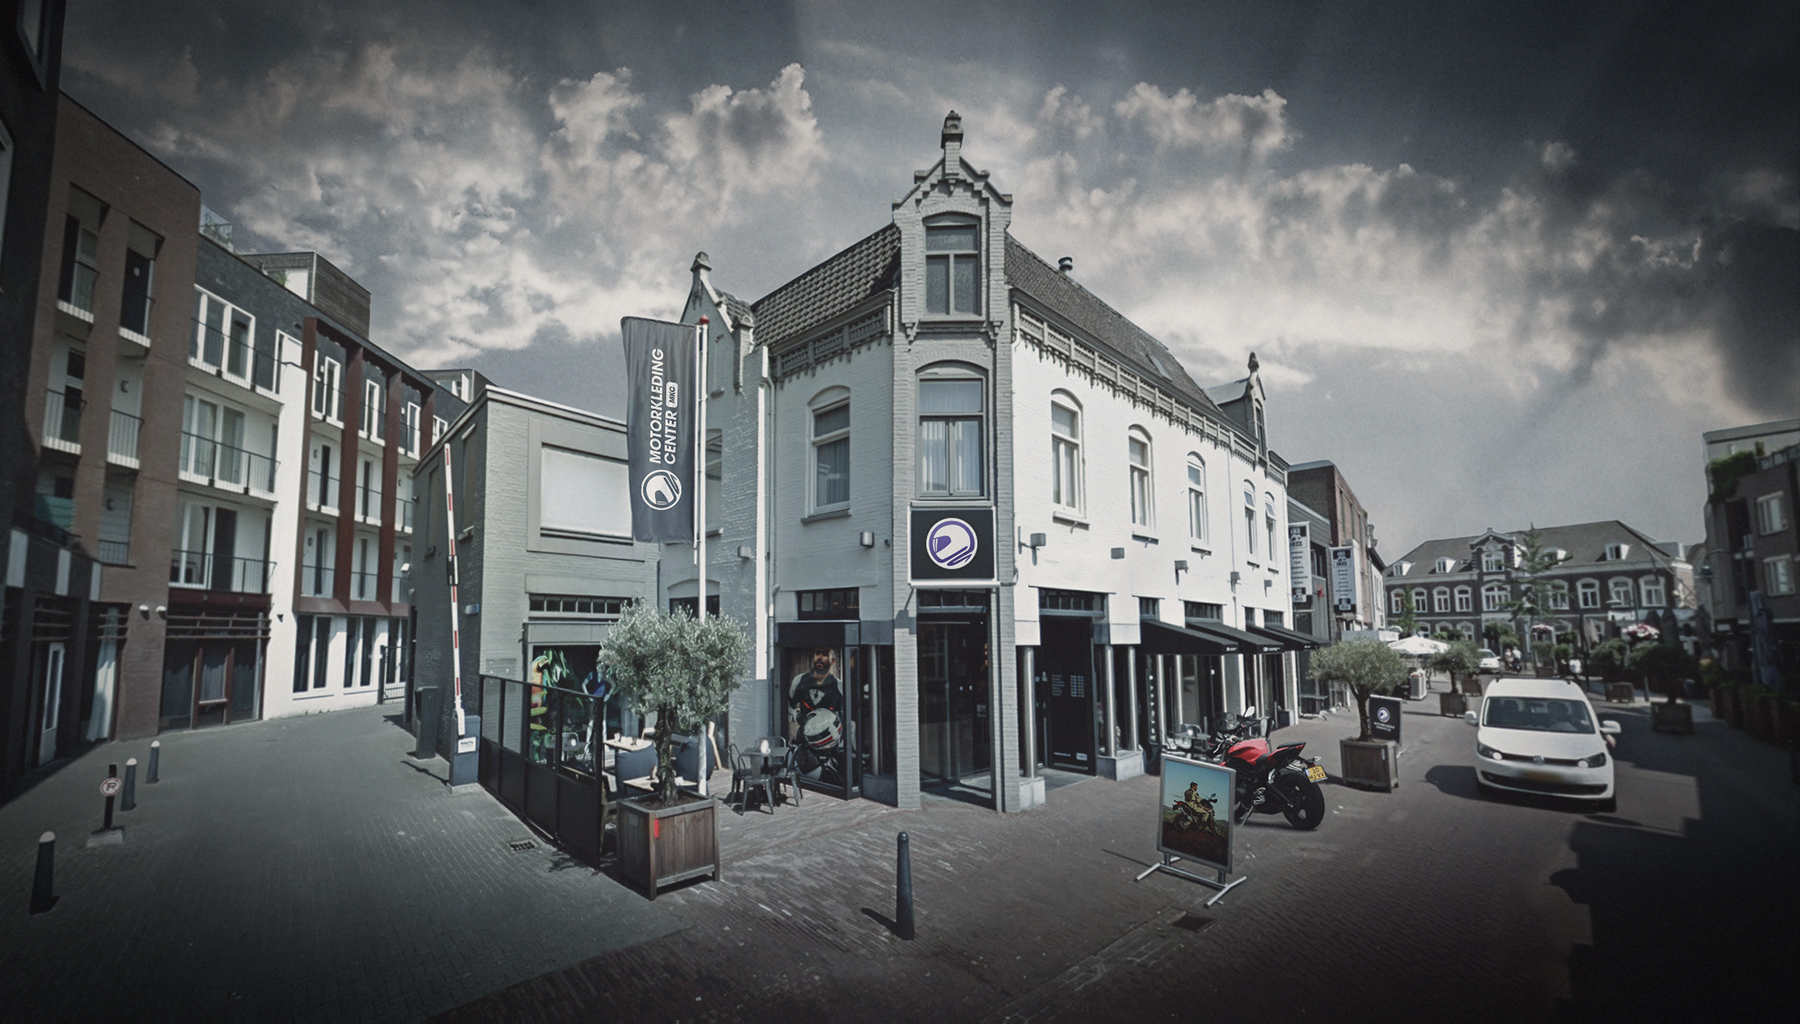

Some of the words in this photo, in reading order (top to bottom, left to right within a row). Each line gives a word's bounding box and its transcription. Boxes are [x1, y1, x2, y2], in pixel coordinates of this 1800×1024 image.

[649, 348, 664, 464] MOTORKLEDING
[668, 385, 676, 404] MKC
[664, 410, 678, 465] CENTER
